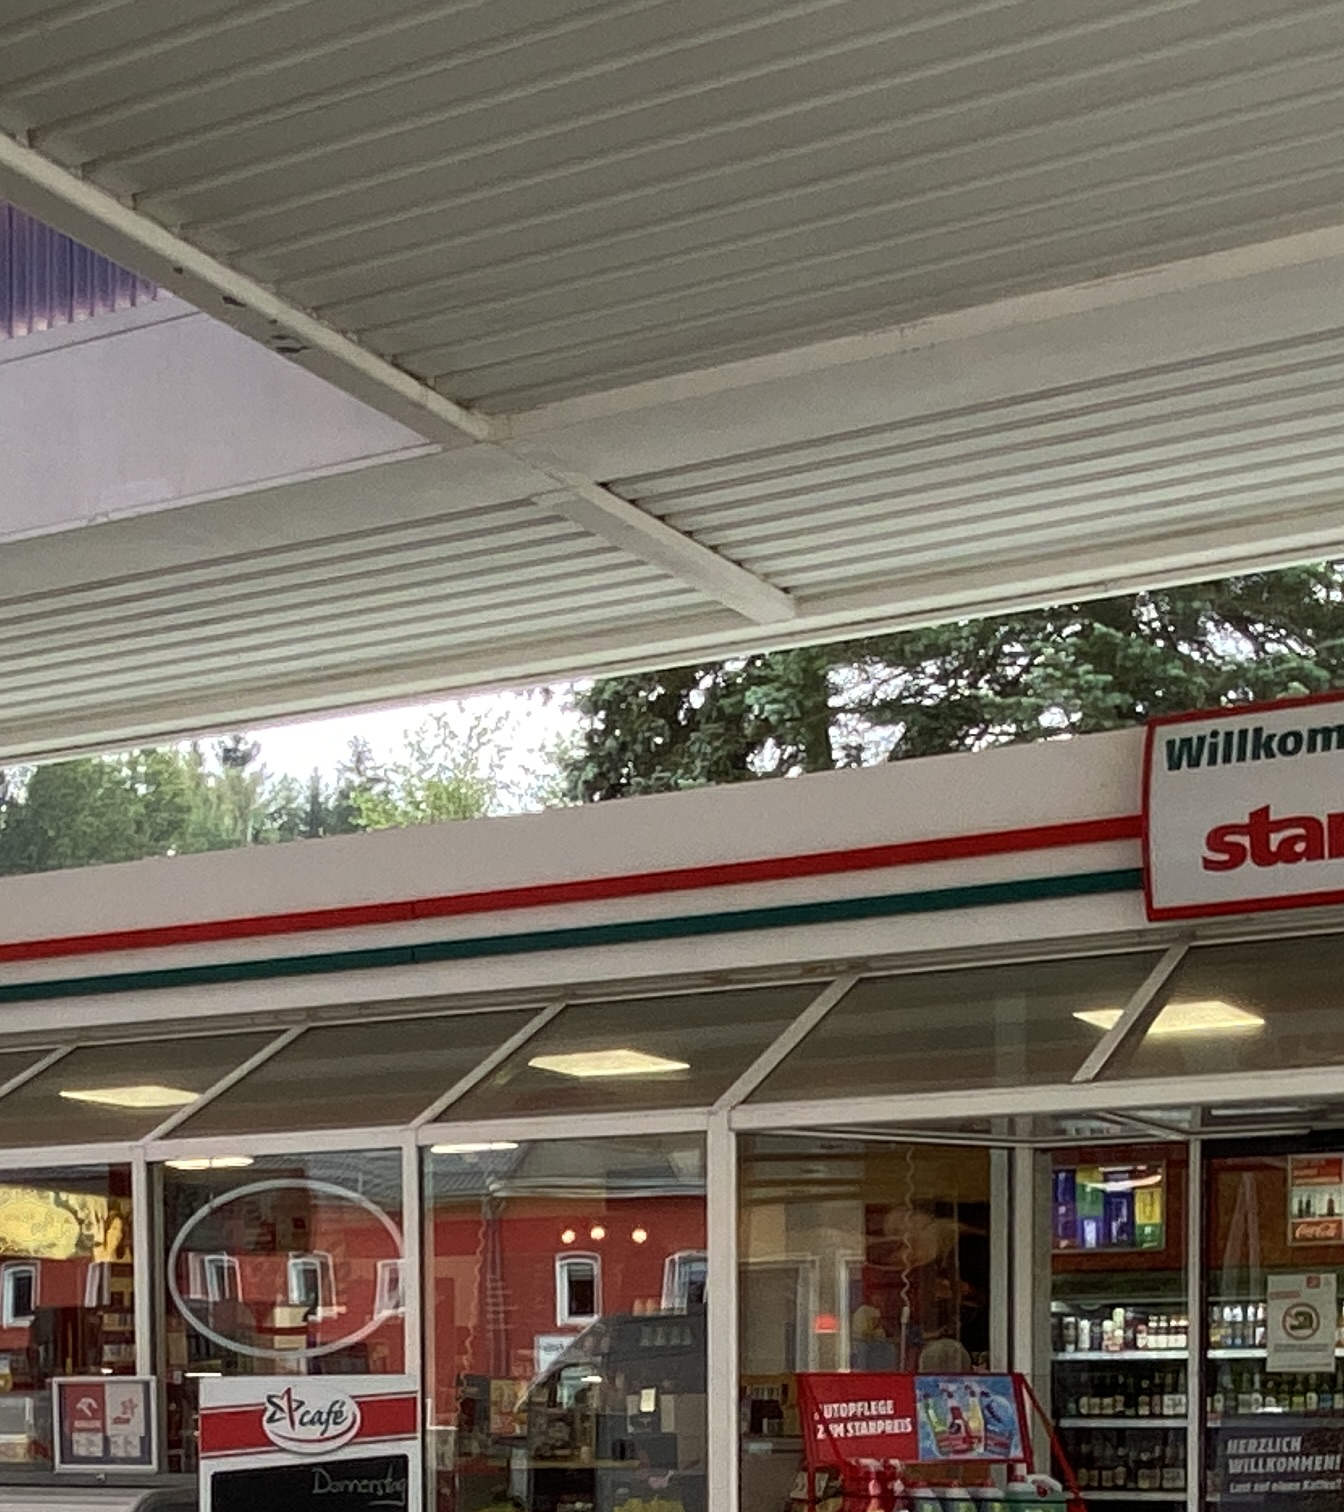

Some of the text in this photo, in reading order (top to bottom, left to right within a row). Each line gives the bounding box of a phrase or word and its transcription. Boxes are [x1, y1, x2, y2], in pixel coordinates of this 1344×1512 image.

[299, 1400, 348, 1437] café
[1227, 1436, 1303, 1454] HERZLICH
[1229, 1453, 1342, 1474] WILLKOMMEN!
